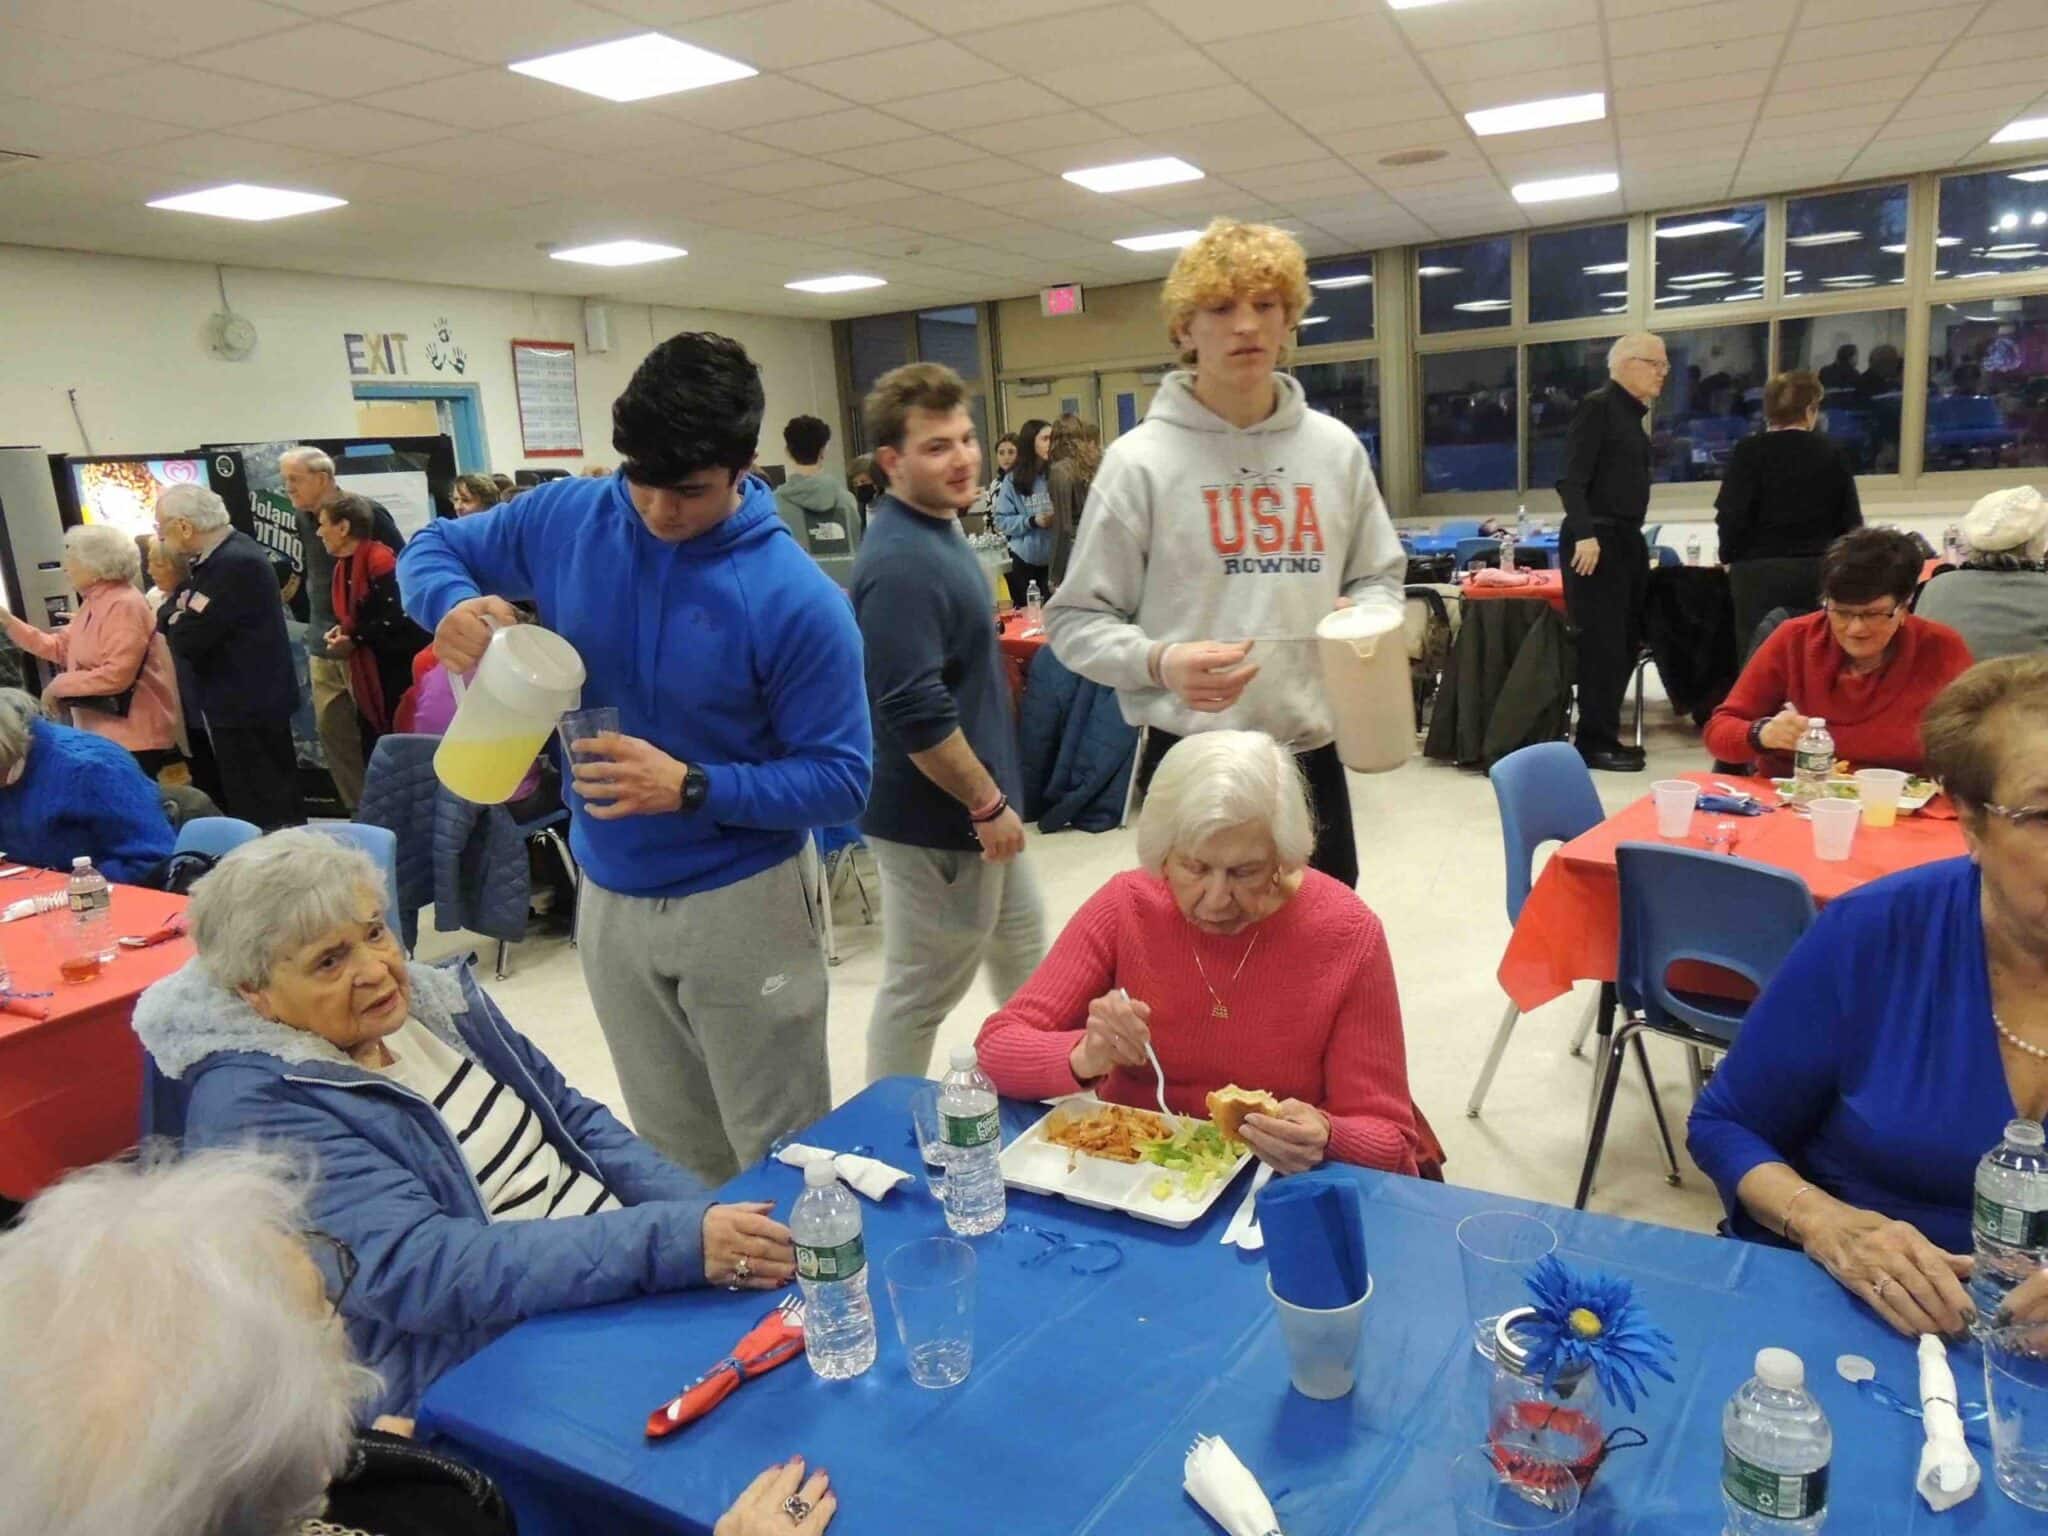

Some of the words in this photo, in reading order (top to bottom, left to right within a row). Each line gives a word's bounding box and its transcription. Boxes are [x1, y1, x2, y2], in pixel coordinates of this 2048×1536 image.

[343, 333, 408, 375] EXIT
[1200, 483, 1326, 558] USA
[1223, 557, 1322, 575] ROWING
